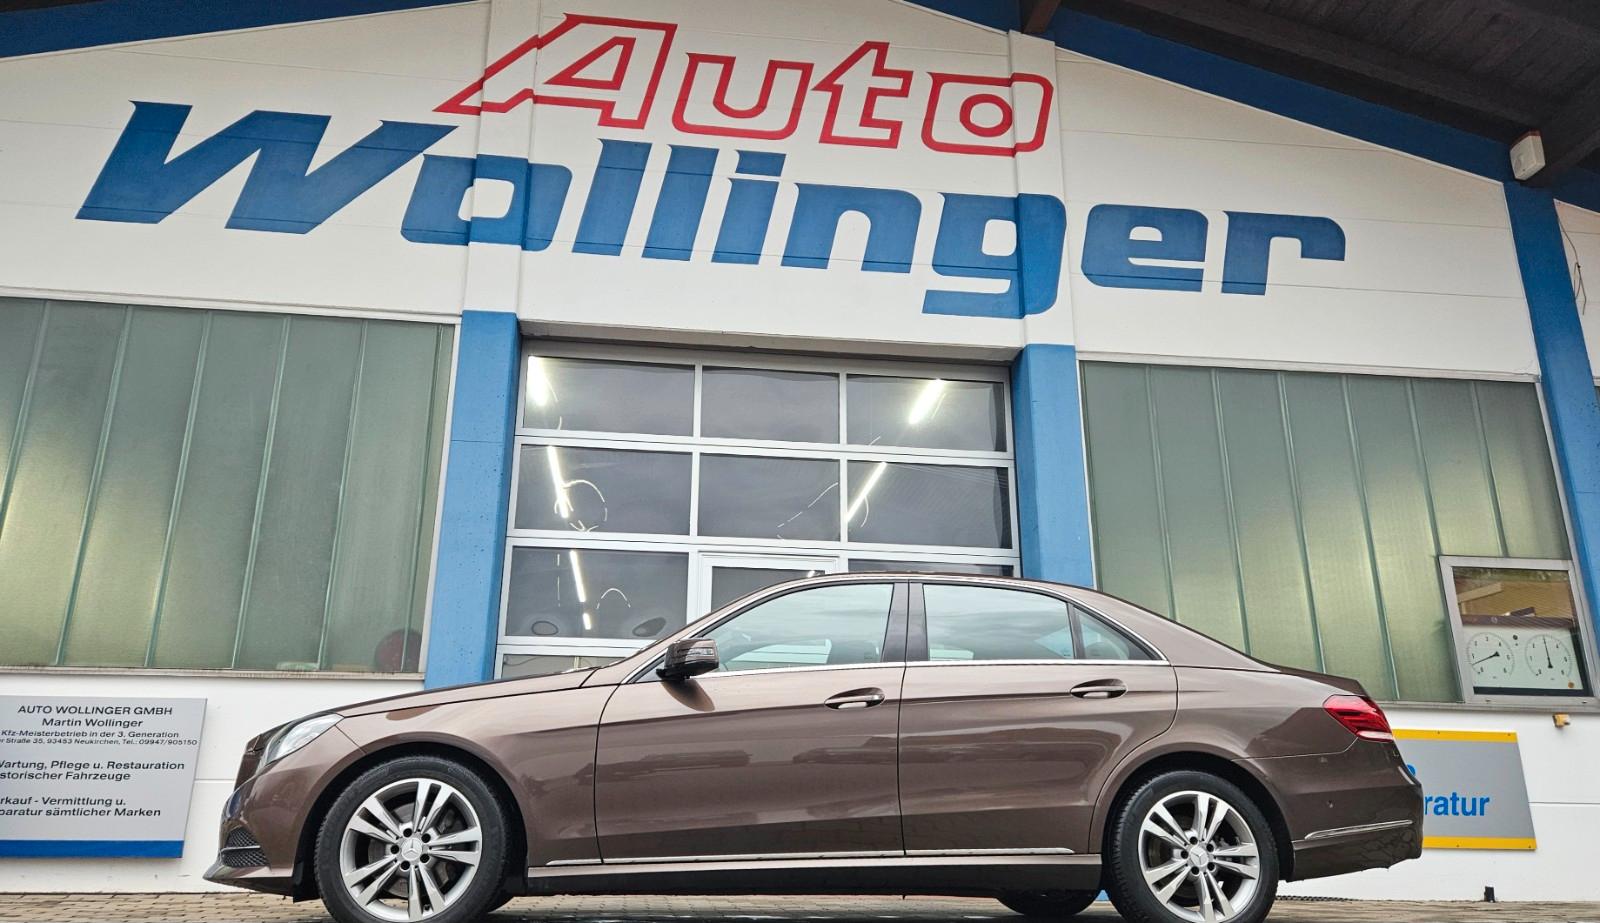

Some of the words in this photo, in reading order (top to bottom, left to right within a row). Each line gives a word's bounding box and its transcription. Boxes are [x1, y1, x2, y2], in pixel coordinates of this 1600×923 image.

[434, 13, 1054, 157] Auto
[75, 100, 1346, 319] Wollinger
[18, 705, 52, 714] AUTO
[56, 706, 131, 715] WOLLINGER
[134, 707, 173, 715] GMBH
[42, 718, 82, 727] Martin
[85, 719, 143, 728] Wollinger
[51, 761, 90, 771] Pflege
[66, 772, 131, 781] Fahrzeuge
[42, 797, 112, 807] Vermittlung
[46, 808, 111, 816] sämtlicher
[114, 808, 161, 816] Marken
